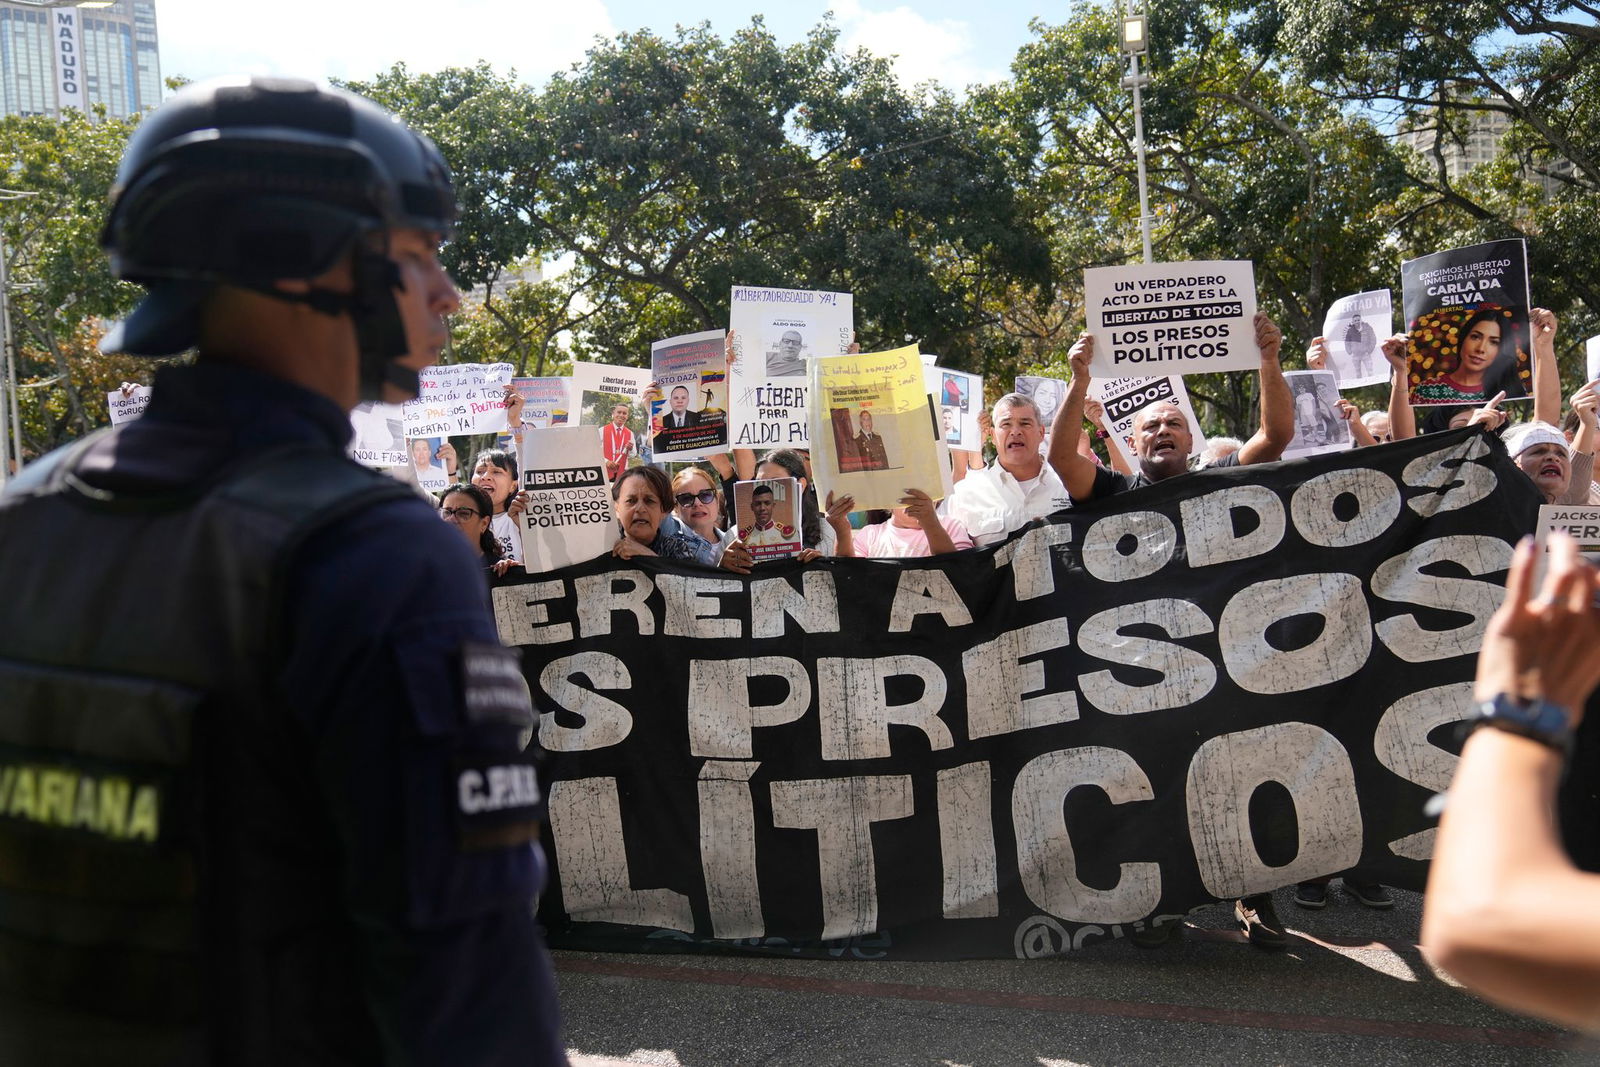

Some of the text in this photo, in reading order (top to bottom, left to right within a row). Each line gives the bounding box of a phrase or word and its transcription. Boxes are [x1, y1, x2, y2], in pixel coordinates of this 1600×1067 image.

[57, 13, 78, 94] MADURO
[1419, 259, 1511, 281] EXIGIMOS LIBERTAD
[1424, 268, 1504, 286] INMEDIATA PARA
[1115, 275, 1226, 292] UN VERDADERO
[1427, 278, 1501, 296] CARLA DA
[819, 293, 837, 306] YA!
[1102, 288, 1237, 307] ACTO DE PAZ ES LA
[1374, 296, 1389, 308] YA
[1441, 291, 1484, 306] SILVA
[1104, 304, 1242, 325] LIBERTAD DE TODOS
[1112, 324, 1230, 346] LOS PRESOS
[1114, 341, 1229, 364] POLÍTICOS
[602, 376, 624, 385] Libertad
[677, 373, 698, 382] DAZA
[466, 389, 476, 400] de
[1101, 379, 1142, 400] LIBERTAD
[1107, 382, 1170, 417] TODOS
[525, 410, 548, 418] DAZA
[759, 408, 788, 419] PARA
[457, 416, 475, 431] YA!
[1113, 418, 1132, 433] LOS
[735, 422, 780, 444] ALDO
[666, 443, 685, 451] FUERTE
[524, 469, 599, 486] LIBERTAD
[560, 488, 607, 501] TODOS
[526, 500, 609, 516] LOS PRESOS
[1551, 512, 1600, 520] JACKS
[527, 511, 611, 529] POLÍTICOS
[492, 433, 1498, 646] EREN A TODOS
[688, 535, 1515, 761] PRESOS
